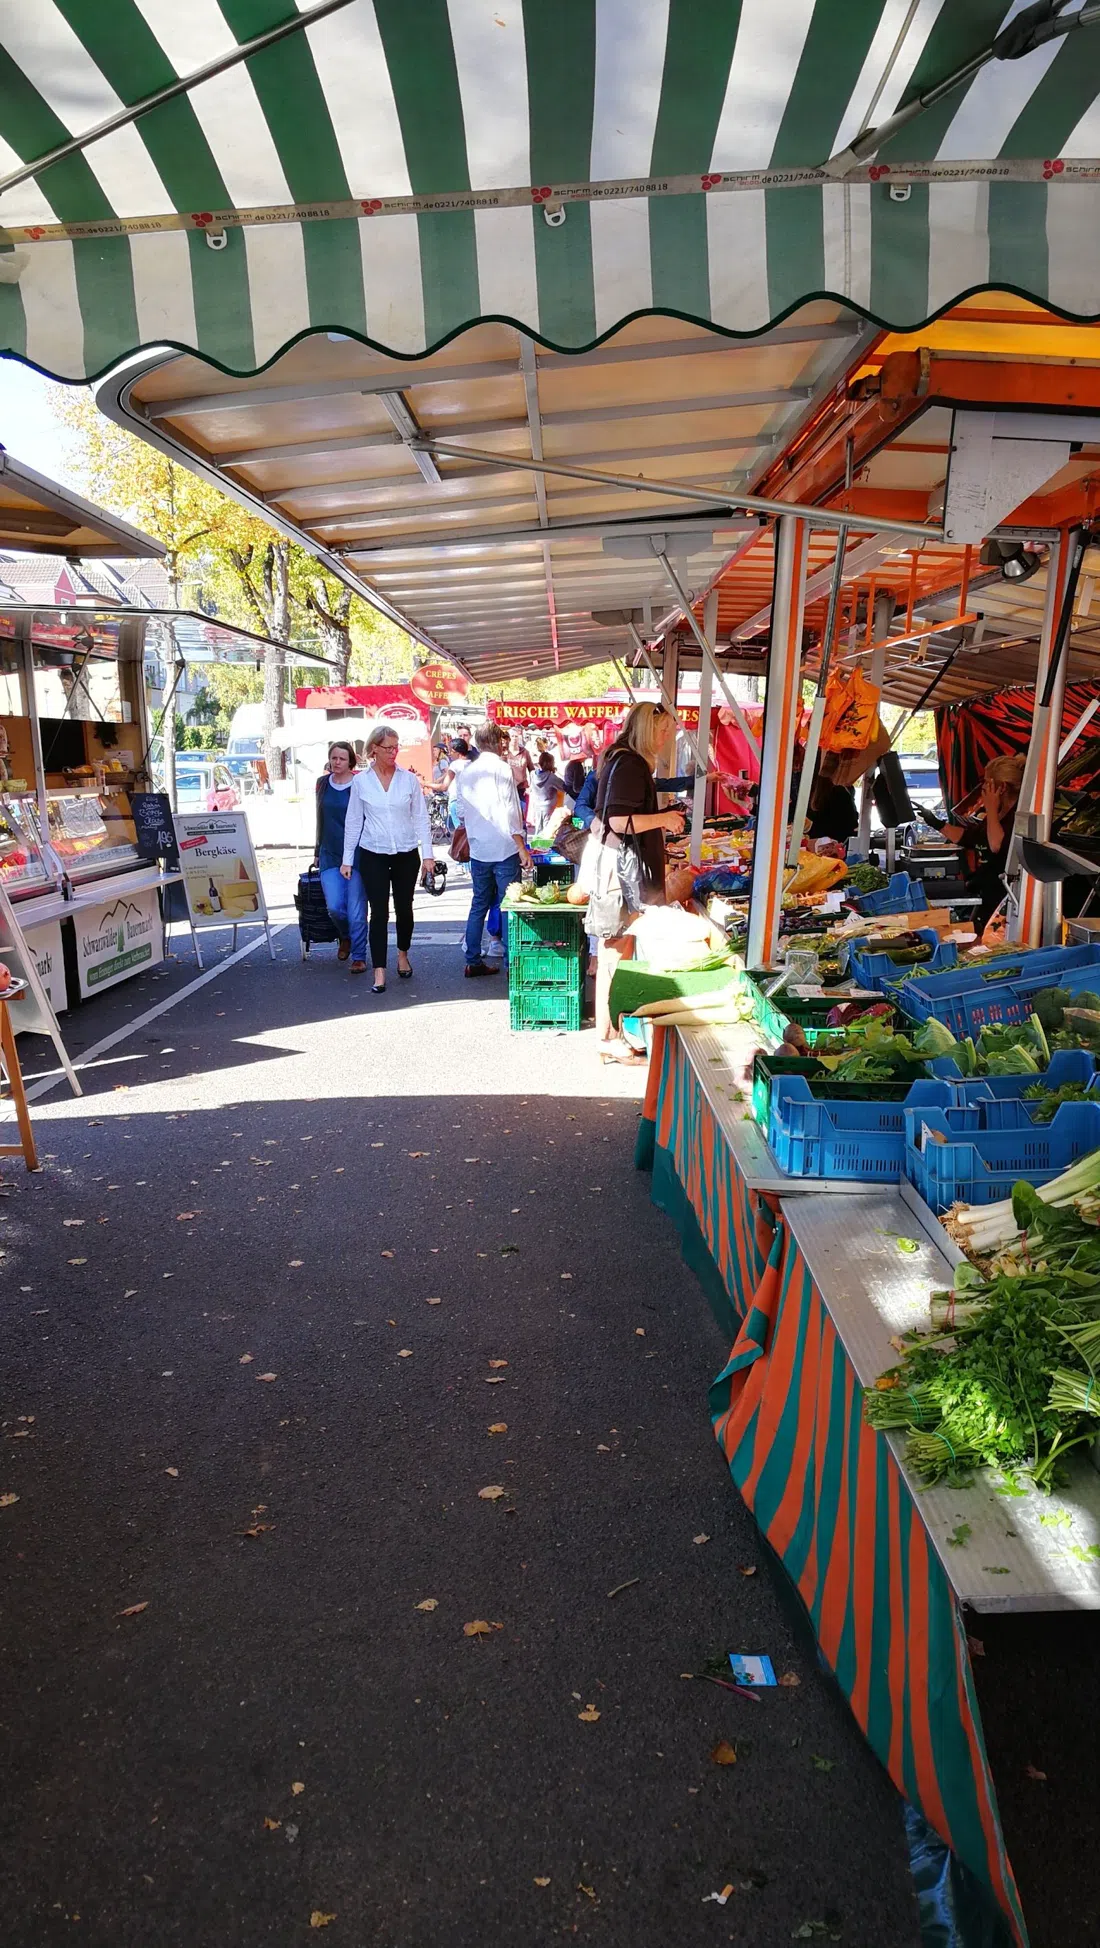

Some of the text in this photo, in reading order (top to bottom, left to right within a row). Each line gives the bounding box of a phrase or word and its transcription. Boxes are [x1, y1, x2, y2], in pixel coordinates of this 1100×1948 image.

[425, 669, 457, 680] CRÊPES
[435, 680, 445, 690] &
[496, 706, 559, 719] FRISCHE
[195, 845, 237, 859] Bergkäse
[82, 913, 154, 958] Schwarzwälder Bauernmarkt
